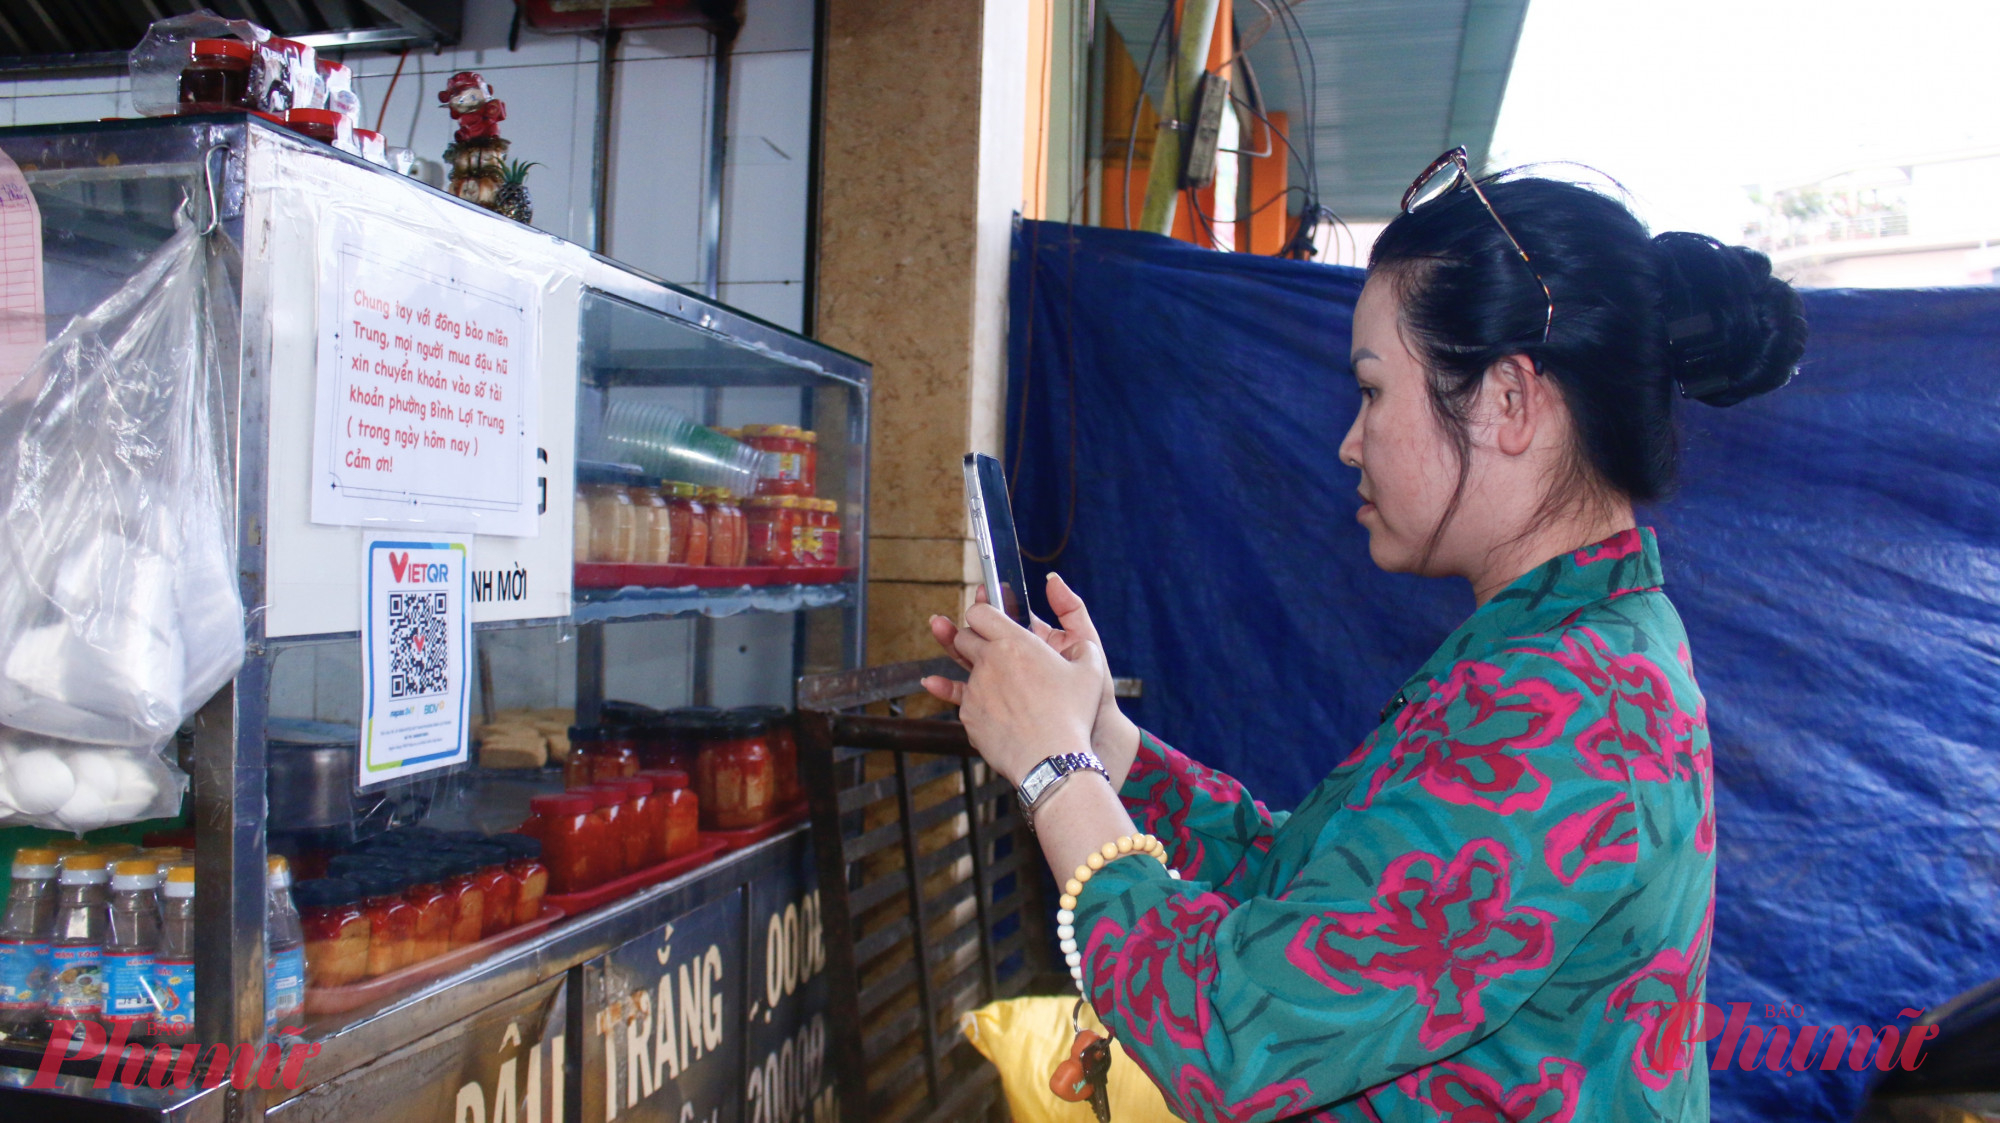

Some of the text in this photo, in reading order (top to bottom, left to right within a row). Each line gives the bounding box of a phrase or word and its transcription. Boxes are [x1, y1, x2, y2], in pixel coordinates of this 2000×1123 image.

[354, 289, 390, 320] Chung
[396, 300, 413, 325] tay
[416, 307, 431, 327] với
[465, 320, 484, 341] bào
[353, 320, 508, 375] Trung, mọi người mua đậu hũ
[351, 353, 370, 373] xin
[374, 358, 414, 383] chuyển
[417, 368, 448, 391] khoản
[451, 375, 471, 395] vào
[489, 383, 503, 402] tài
[349, 384, 505, 435] khoản phường Bình Lợi Trung
[345, 448, 393, 473] Cảm ơn!
[358, 419, 391, 447] trong
[394, 425, 420, 450] ngày
[424, 430, 447, 450] hôm
[450, 438, 471, 457] nay
[497, 560, 527, 601] MỜI
